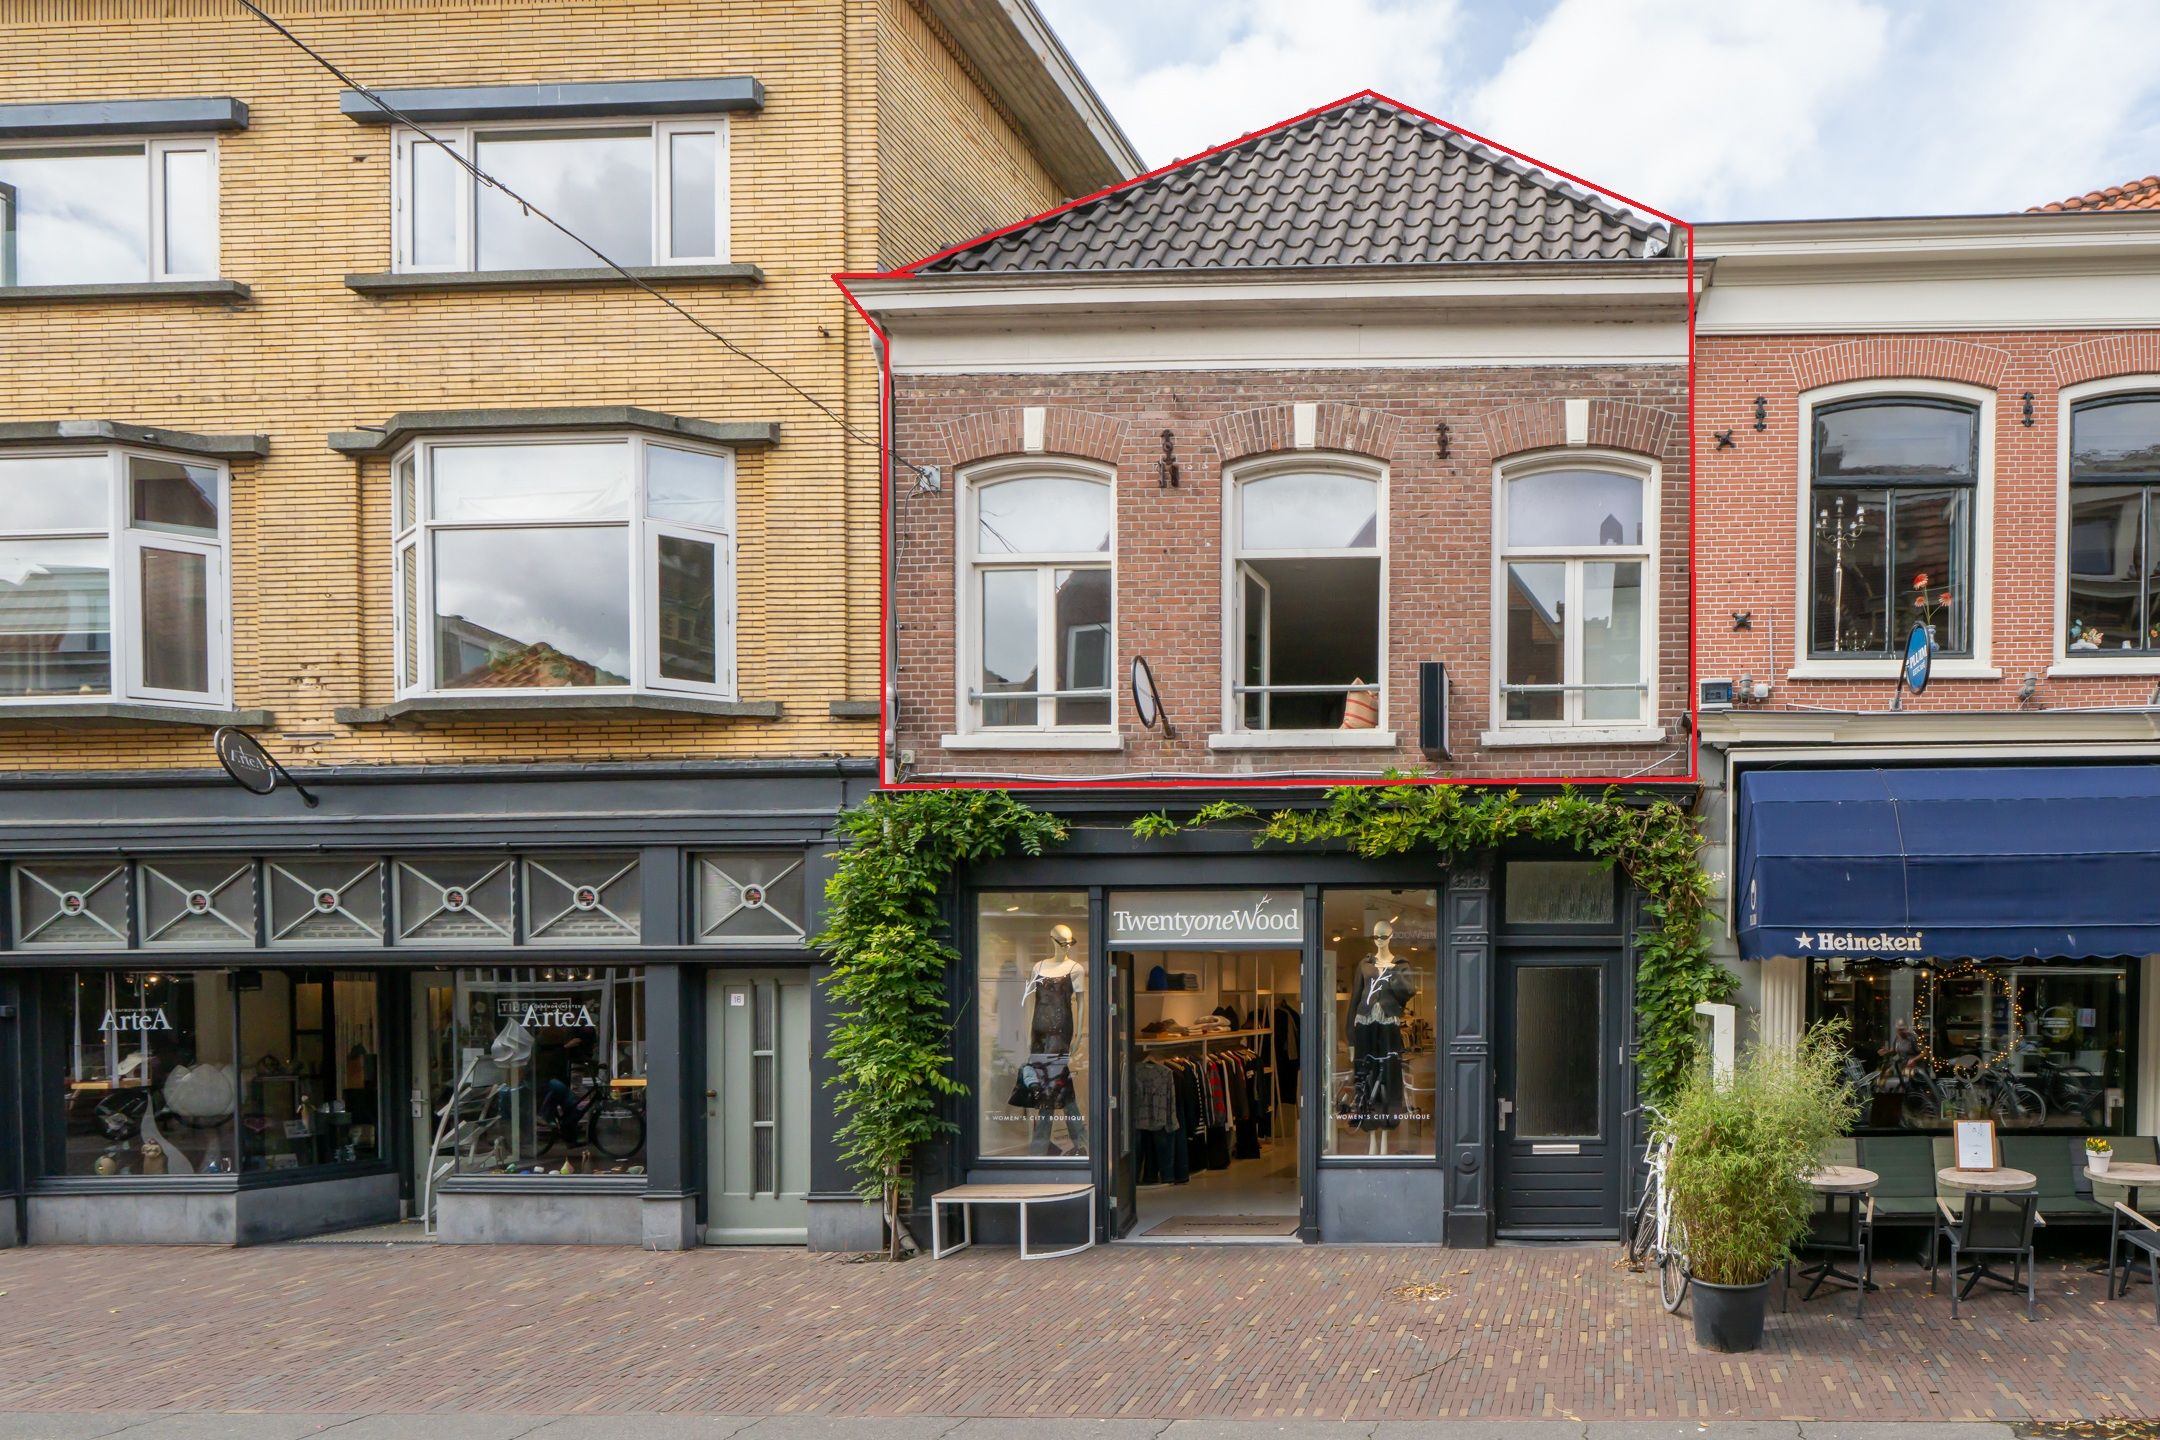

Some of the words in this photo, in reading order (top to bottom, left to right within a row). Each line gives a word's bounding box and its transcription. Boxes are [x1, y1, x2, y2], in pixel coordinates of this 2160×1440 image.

[1113, 906, 1300, 937] TwentyoneWood
[1817, 932, 1922, 951] Heineken
[98, 1008, 173, 1030] ArteA
[520, 1004, 596, 1027] ArteA
